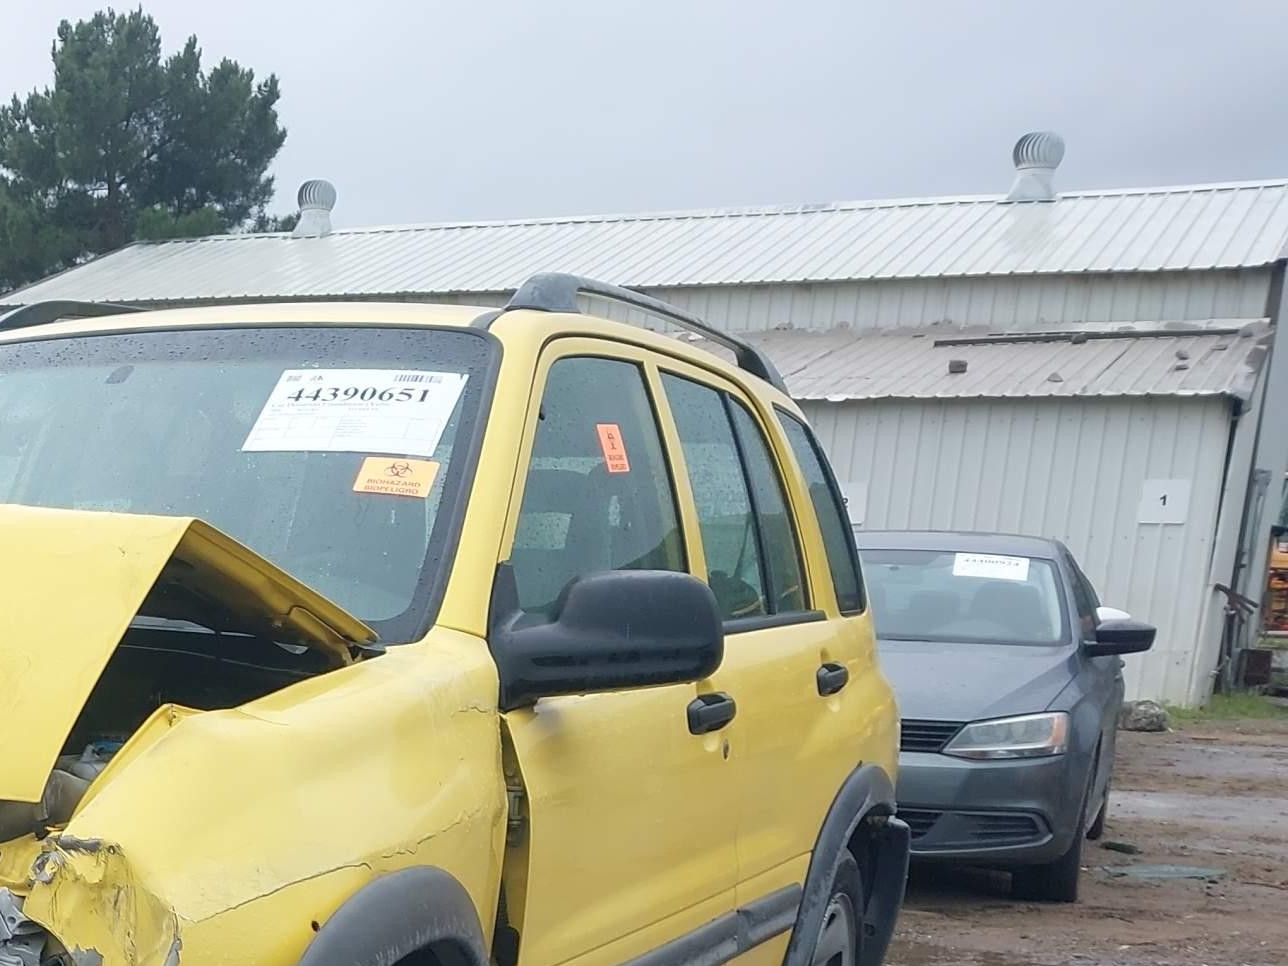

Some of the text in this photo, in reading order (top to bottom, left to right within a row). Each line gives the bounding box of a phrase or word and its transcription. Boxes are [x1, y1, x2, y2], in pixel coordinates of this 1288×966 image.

[287, 387, 431, 402] 44390651
[366, 478, 421, 487] BIOHAZARD
[1159, 494, 1168, 506] 1
